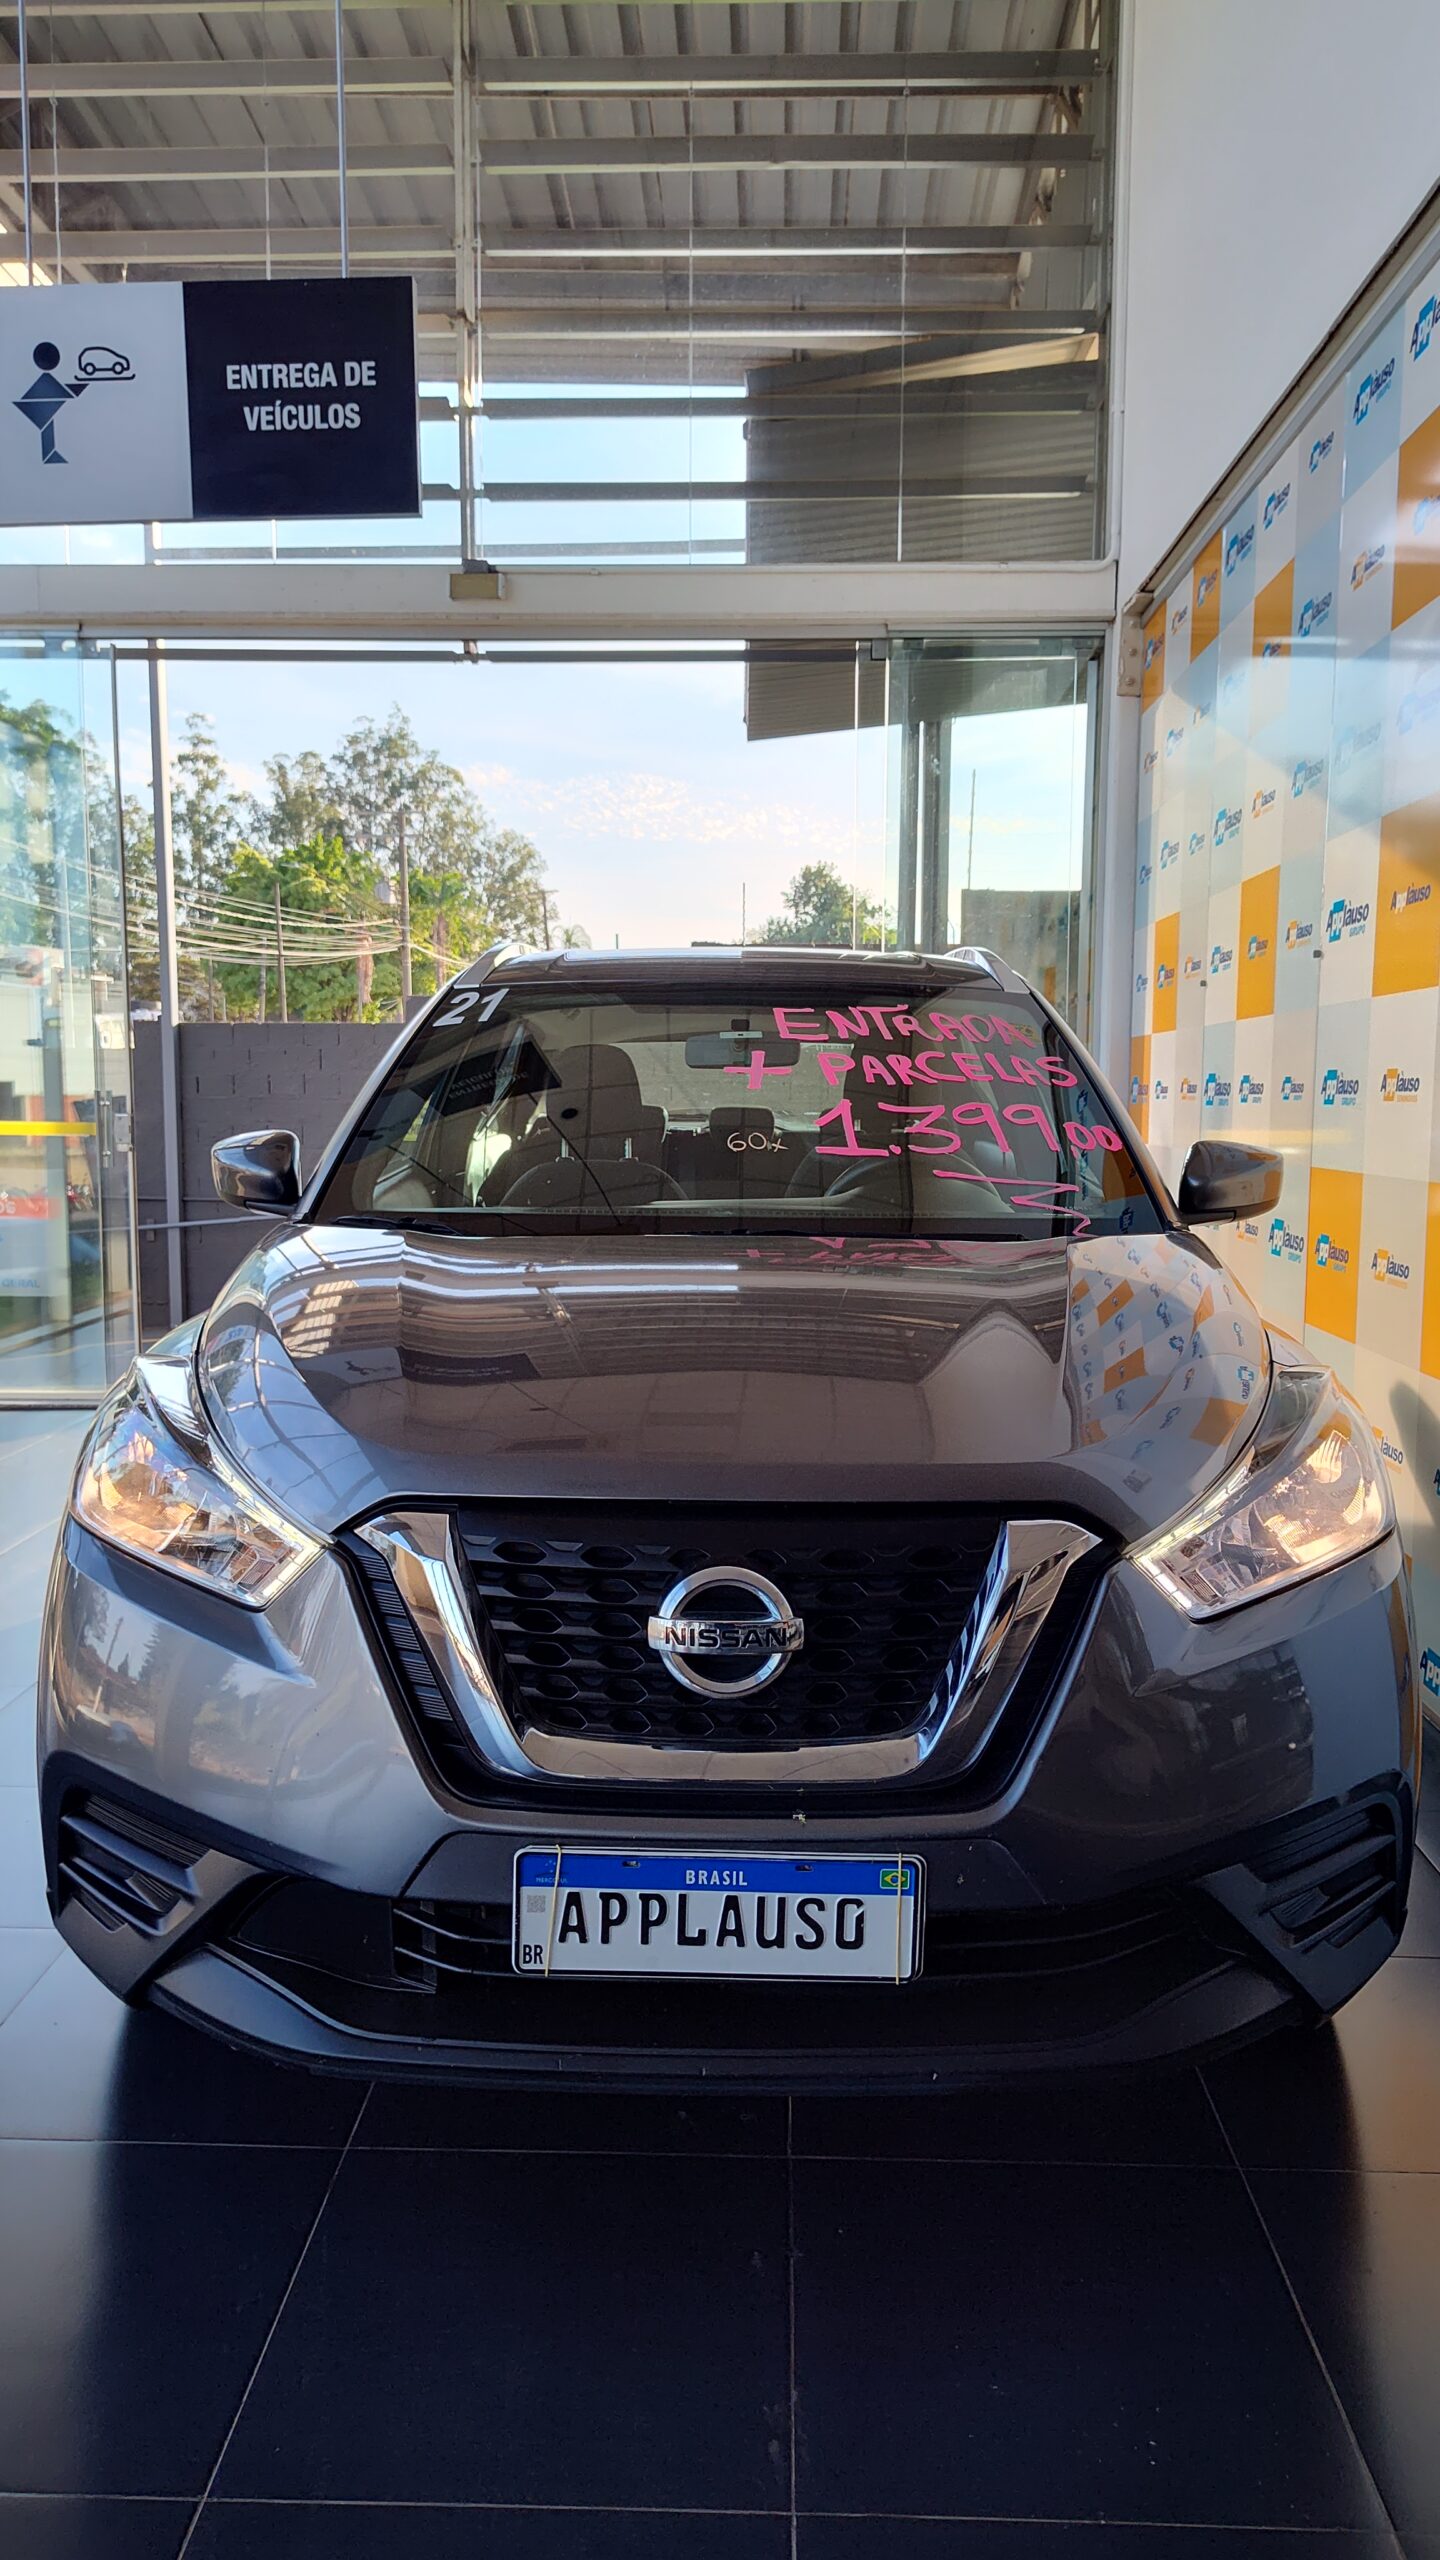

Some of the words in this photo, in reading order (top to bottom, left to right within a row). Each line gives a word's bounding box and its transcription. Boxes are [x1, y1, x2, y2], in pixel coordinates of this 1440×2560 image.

[226, 362, 338, 390] ENTREGA
[344, 360, 377, 387] DE
[243, 400, 361, 431] VEÍCULOS
[433, 988, 510, 1027] 21
[773, 1004, 1036, 1048] ENTRADA
[817, 1051, 1078, 1087] PARCELAS
[665, 1627, 788, 1648] NISSAN
[685, 1869, 748, 1886] BRASIL
[558, 1891, 865, 1950] APPLAUSO
[522, 1944, 544, 1966] BR
